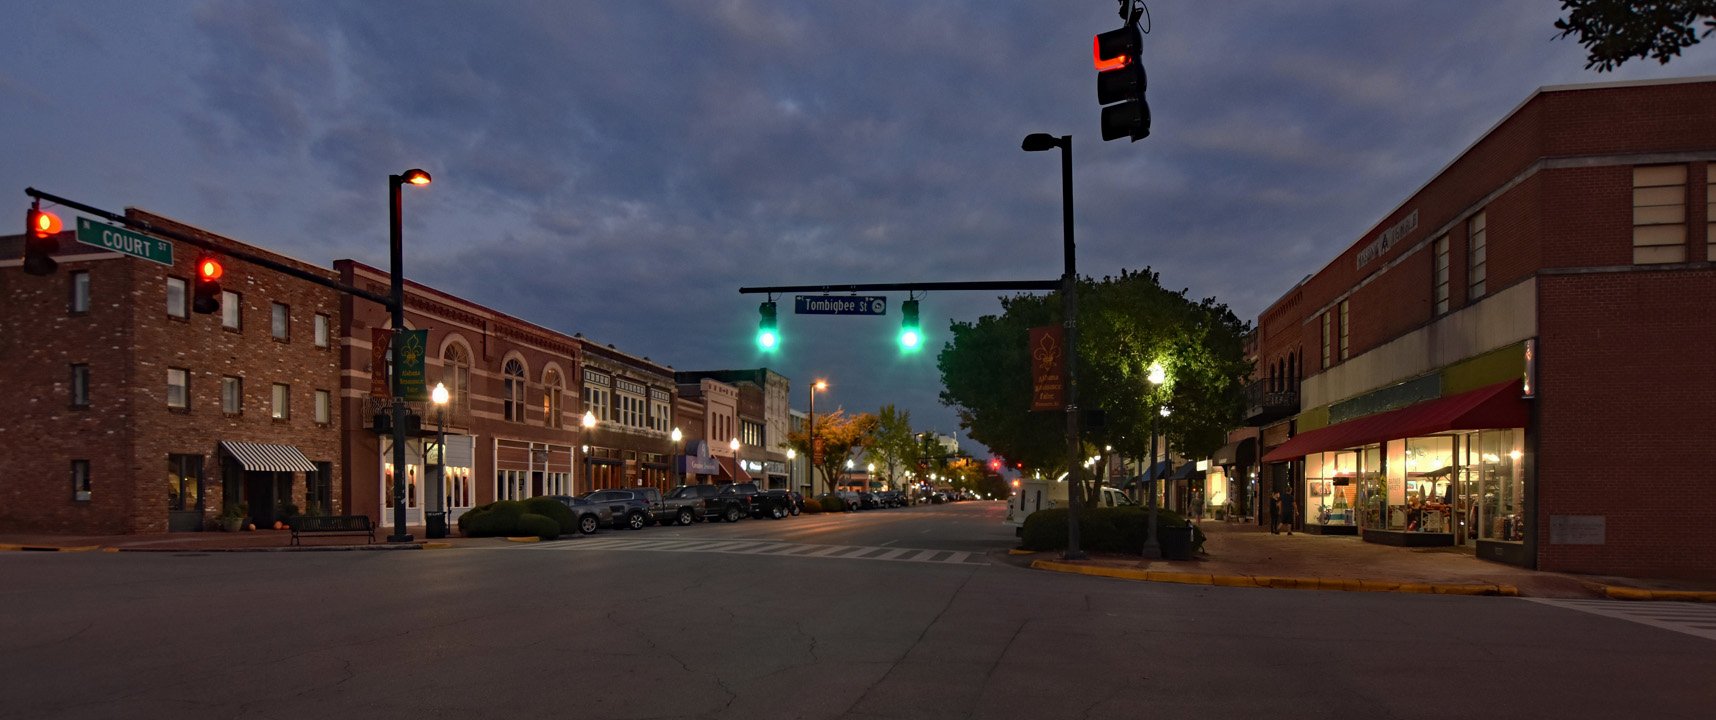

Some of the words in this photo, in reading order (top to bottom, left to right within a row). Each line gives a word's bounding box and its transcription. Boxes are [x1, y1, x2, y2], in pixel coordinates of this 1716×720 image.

[103, 230, 151, 257] COURT
[158, 242, 167, 251] ST
[805, 298, 855, 314] Tombigbee
[859, 301, 867, 312] St
